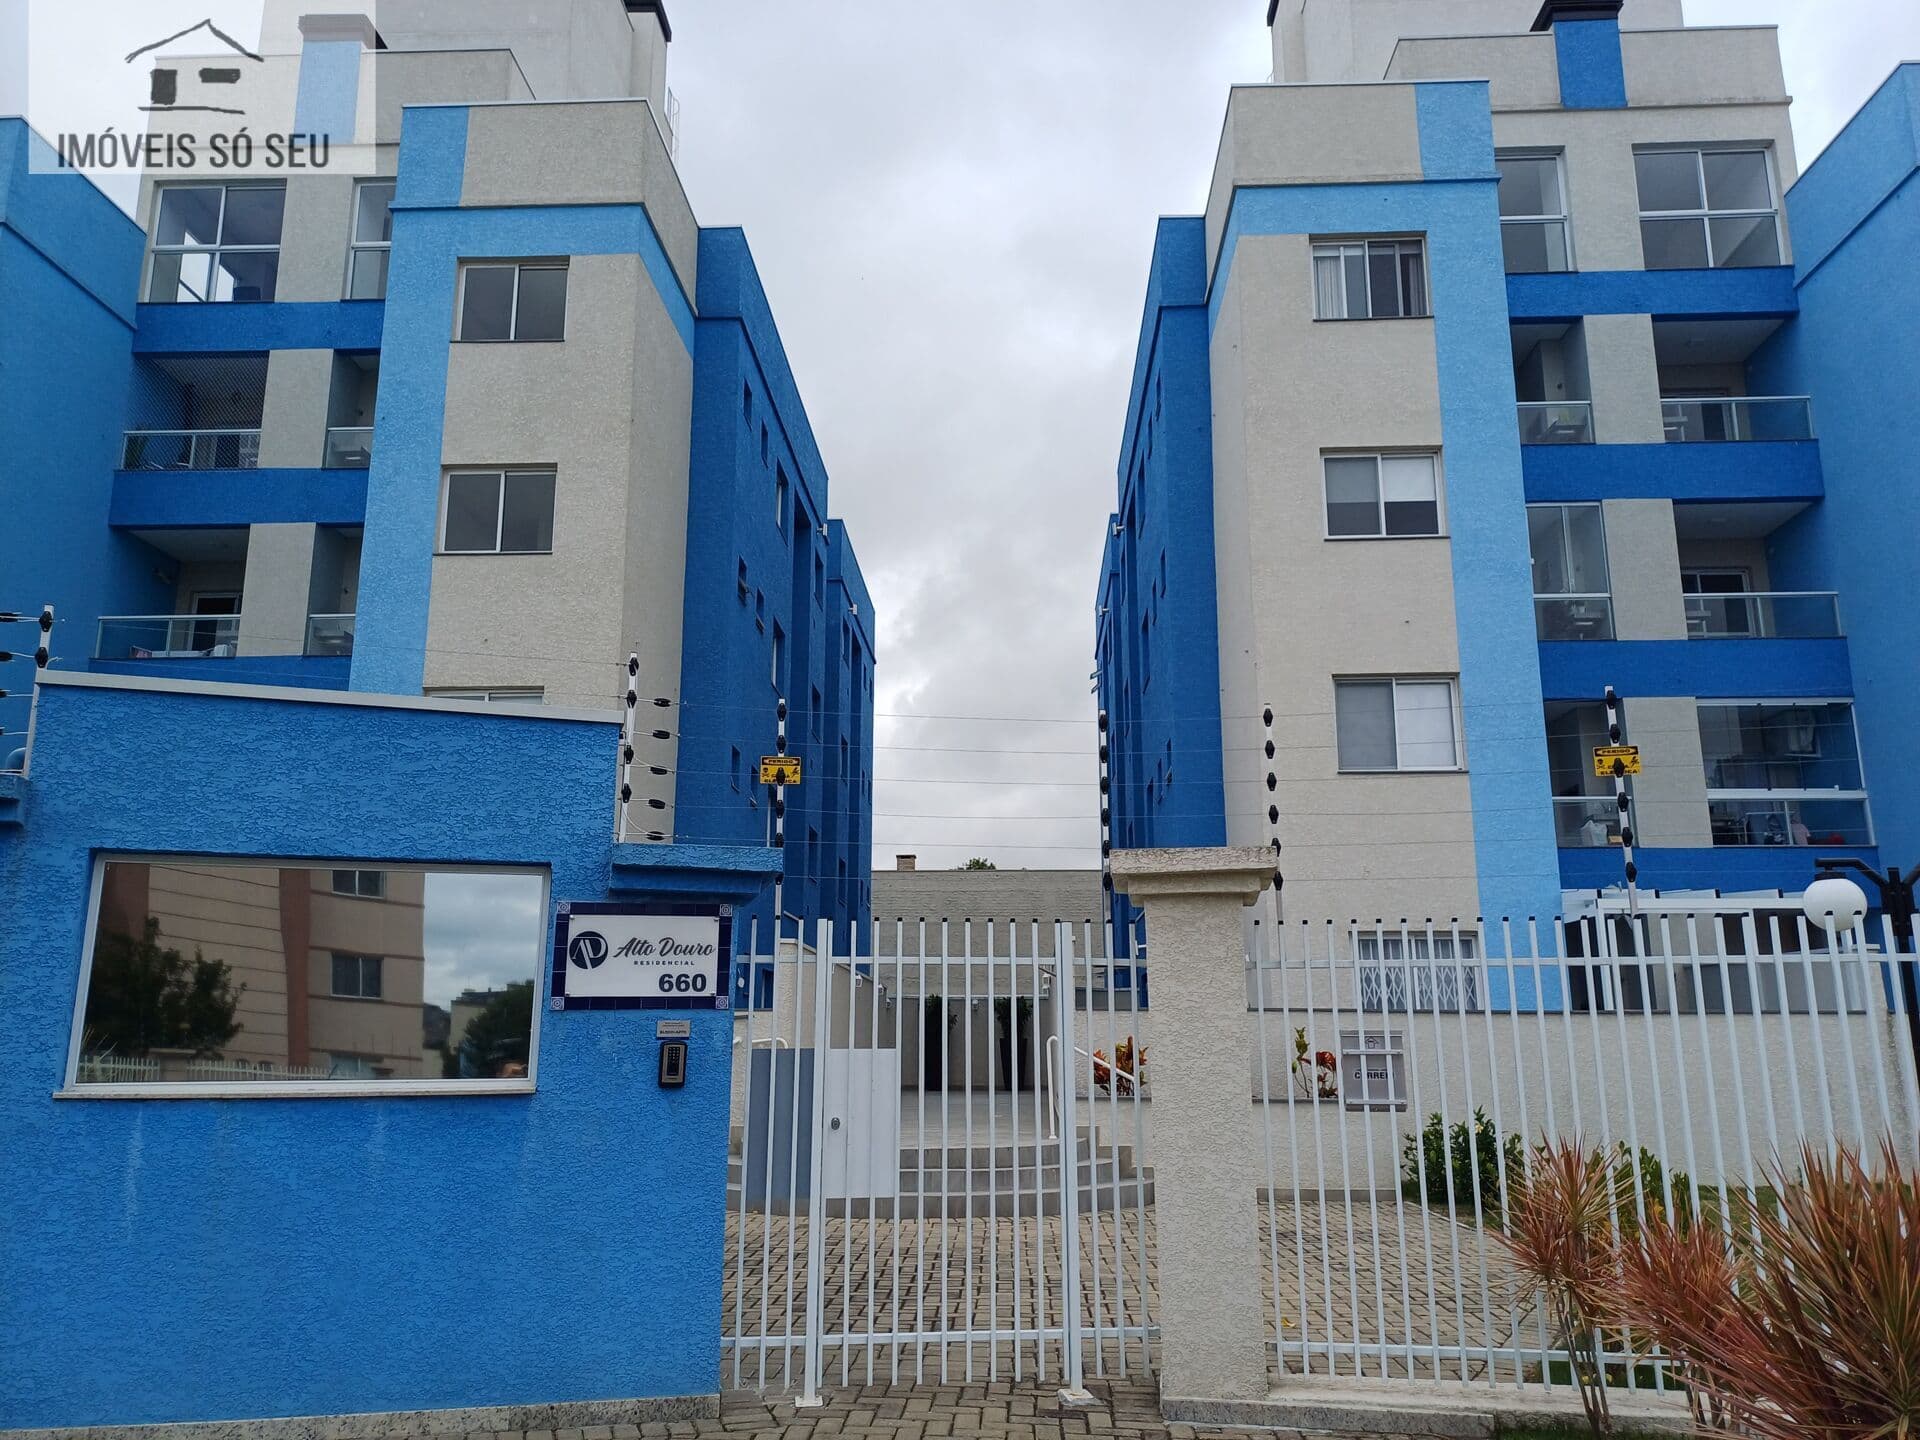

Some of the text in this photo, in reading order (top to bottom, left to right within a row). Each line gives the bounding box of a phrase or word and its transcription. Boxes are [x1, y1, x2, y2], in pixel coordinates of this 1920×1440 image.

[613, 937, 716, 958] Alto Douro
[658, 973, 707, 992] 660
